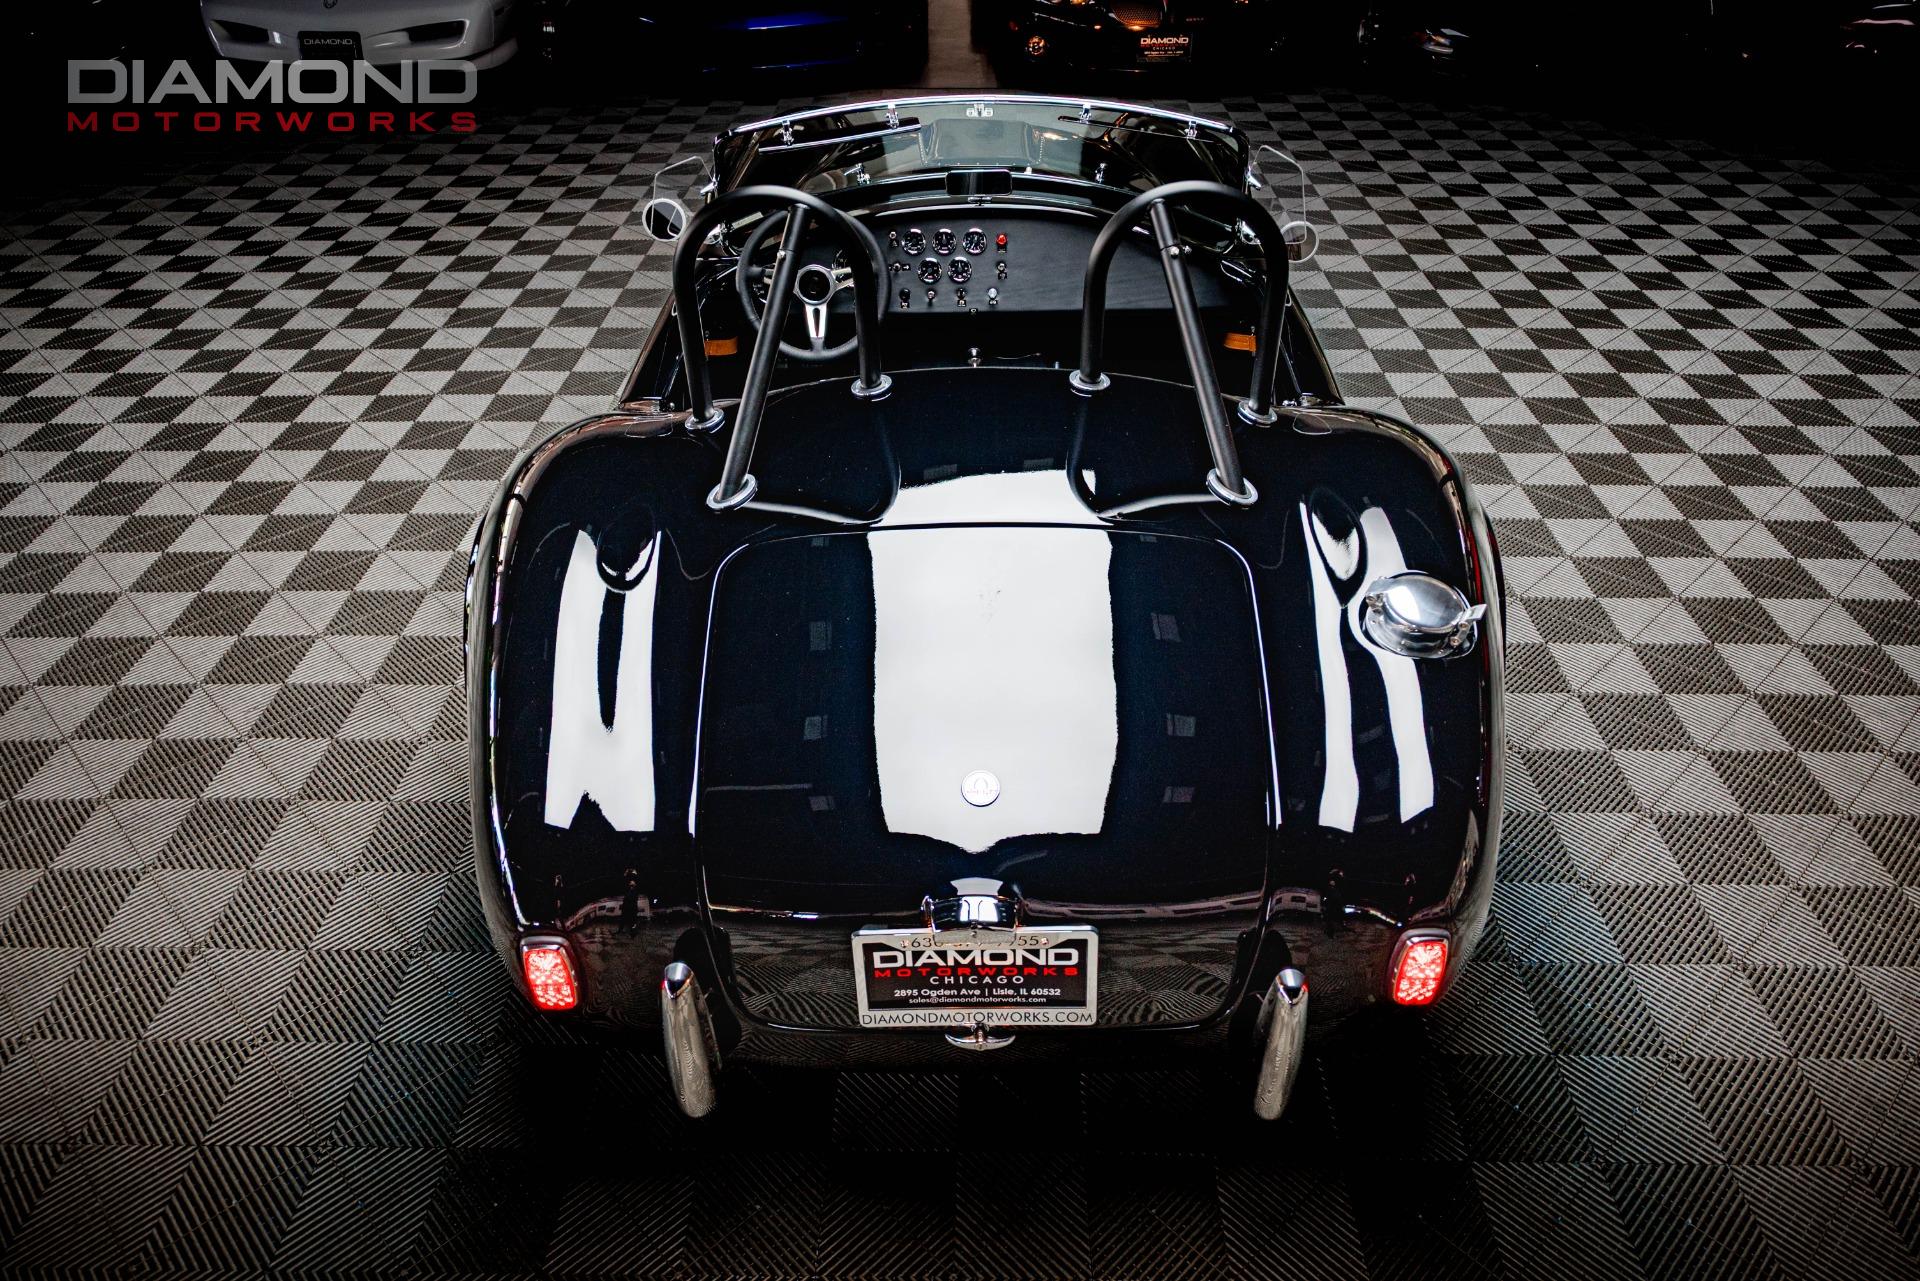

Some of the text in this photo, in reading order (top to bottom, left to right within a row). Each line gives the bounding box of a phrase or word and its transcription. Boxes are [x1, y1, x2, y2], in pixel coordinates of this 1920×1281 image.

[872, 948, 1079, 968] DIAMOND
[873, 967, 1079, 978] MOTORWORKS
[930, 976, 1025, 985] CHICAGO
[894, 989, 918, 997] 2895
[920, 988, 957, 998] Ogden
[960, 988, 981, 996] Ave
[992, 988, 1017, 996] Lisle,
[1019, 988, 1028, 996] IL
[1031, 988, 1061, 996] 60532
[908, 996, 1047, 1004] sales@diamondmotorworks.com
[861, 1011, 1094, 1025] DIAMONDMOTORWORKS.COM
